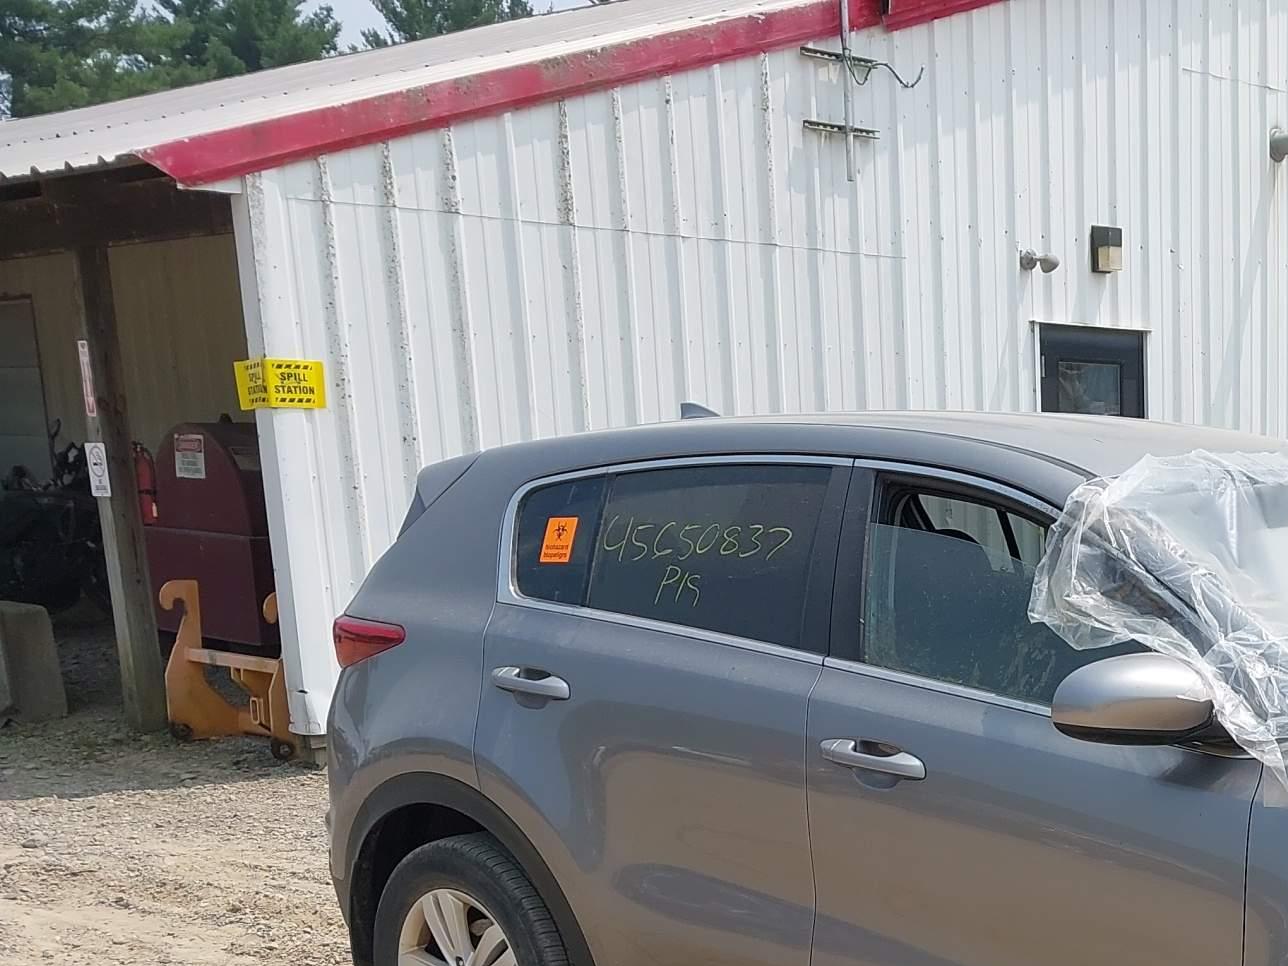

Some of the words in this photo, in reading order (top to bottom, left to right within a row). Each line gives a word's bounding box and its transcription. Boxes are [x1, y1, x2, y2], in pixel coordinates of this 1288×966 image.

[280, 372, 308, 382] SPILL
[274, 385, 315, 395] STATION
[603, 515, 793, 562] 45650837
